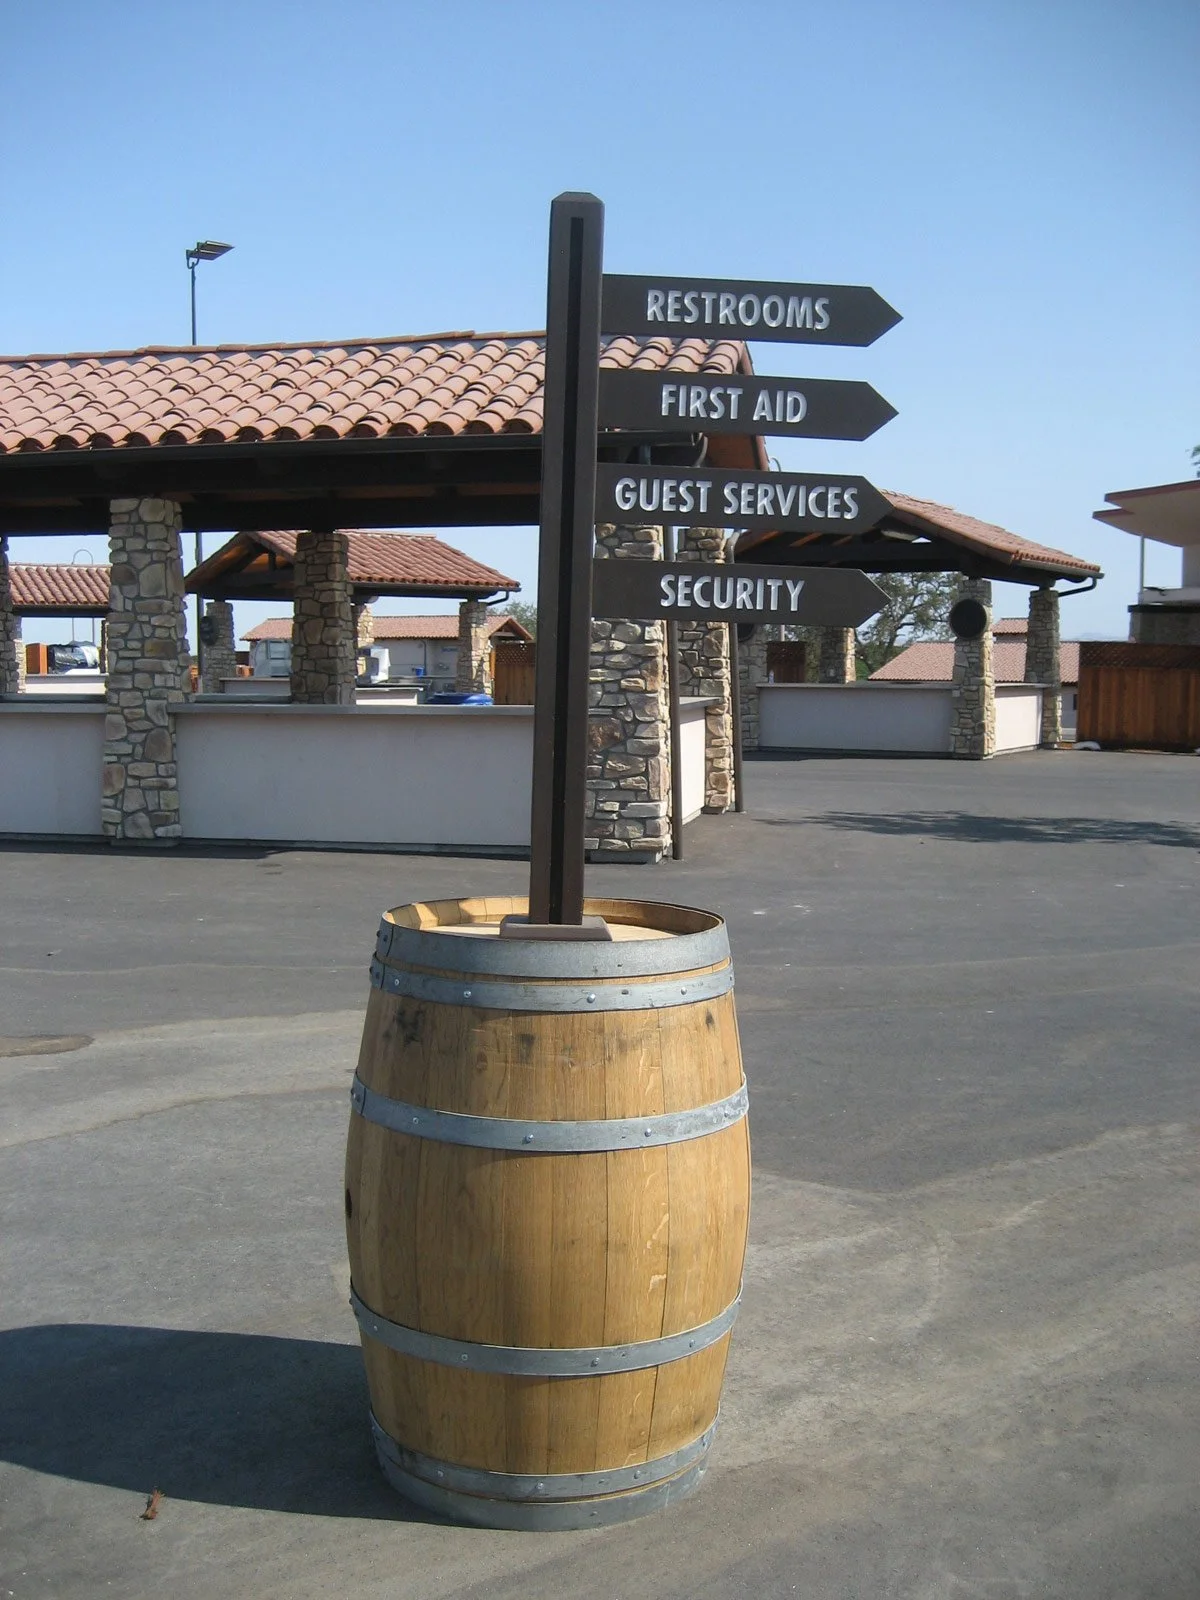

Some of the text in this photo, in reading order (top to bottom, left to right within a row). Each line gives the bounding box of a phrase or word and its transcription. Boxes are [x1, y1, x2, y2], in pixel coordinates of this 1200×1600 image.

[646, 289, 831, 331] RESTROOMS
[660, 384, 808, 424] FIRST AID
[614, 477, 859, 520] GUEST SERVICES
[660, 574, 805, 612] SECURITY
